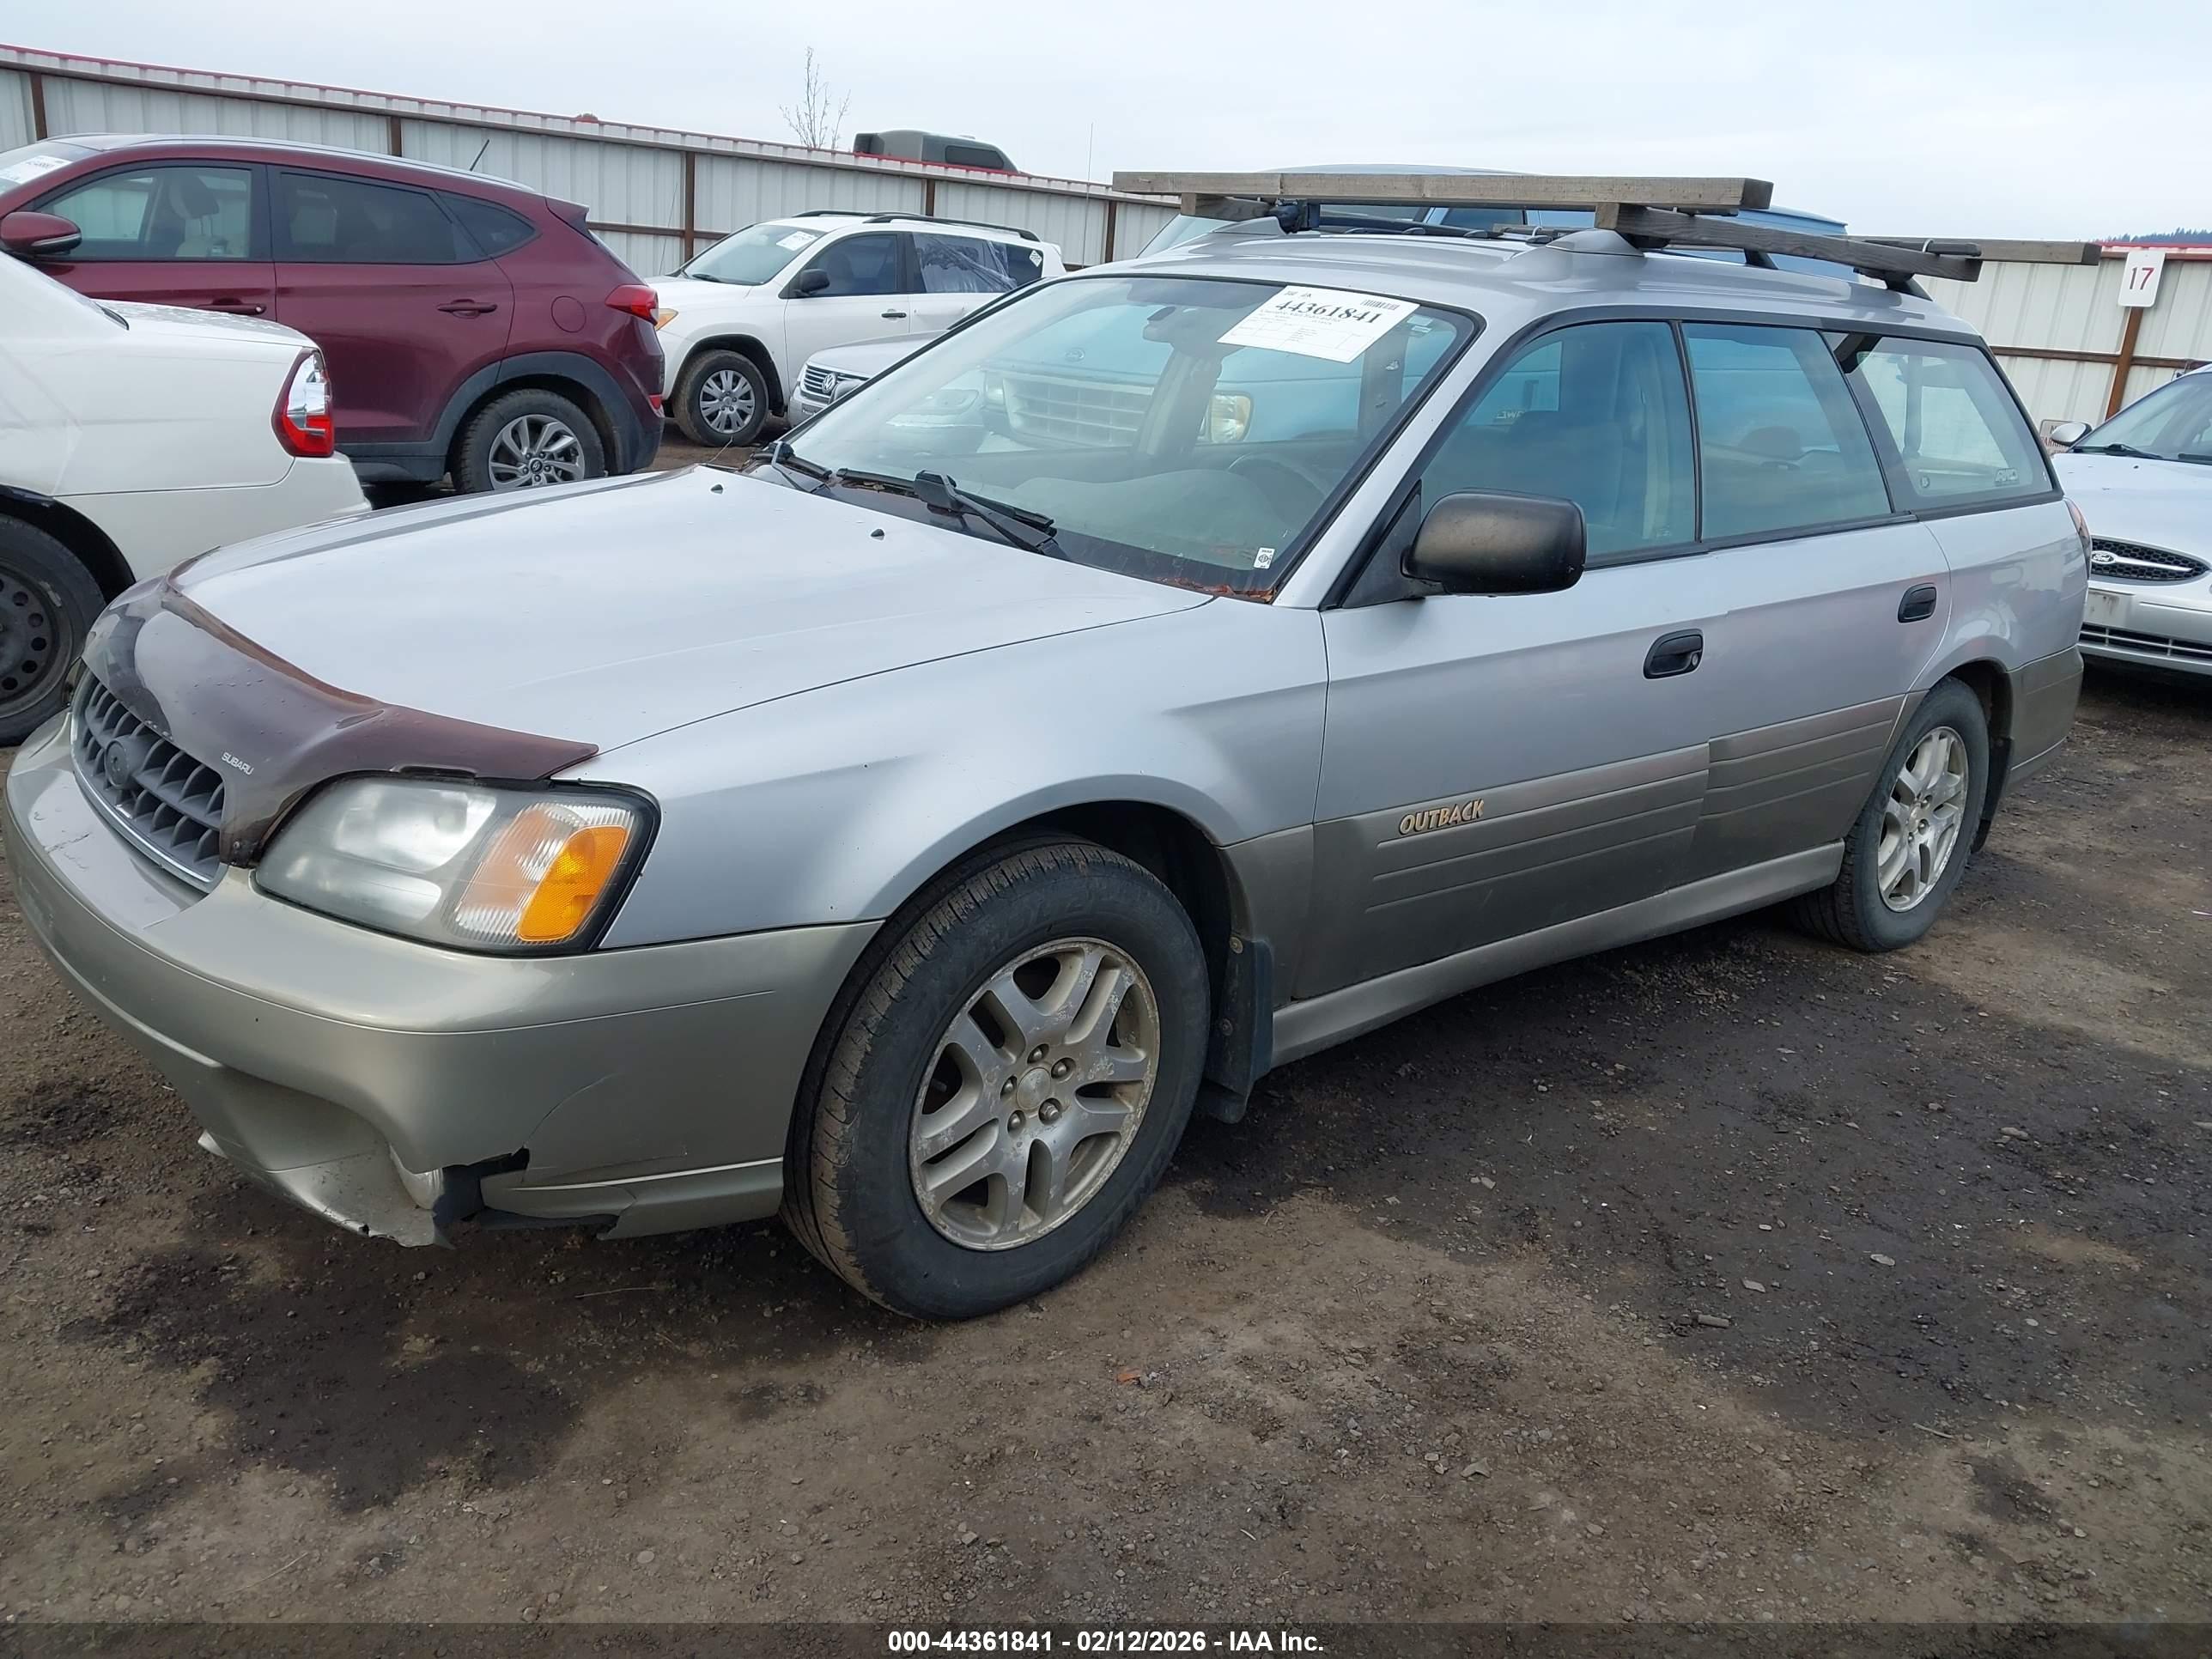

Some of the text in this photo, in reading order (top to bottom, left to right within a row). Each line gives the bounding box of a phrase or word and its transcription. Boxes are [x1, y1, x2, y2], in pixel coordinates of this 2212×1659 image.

[2129, 266, 2155, 290] 17
[1275, 300, 1382, 325] 44361841
[221, 751, 255, 775] SUBARU
[1399, 799, 1485, 835] OUTBACK
